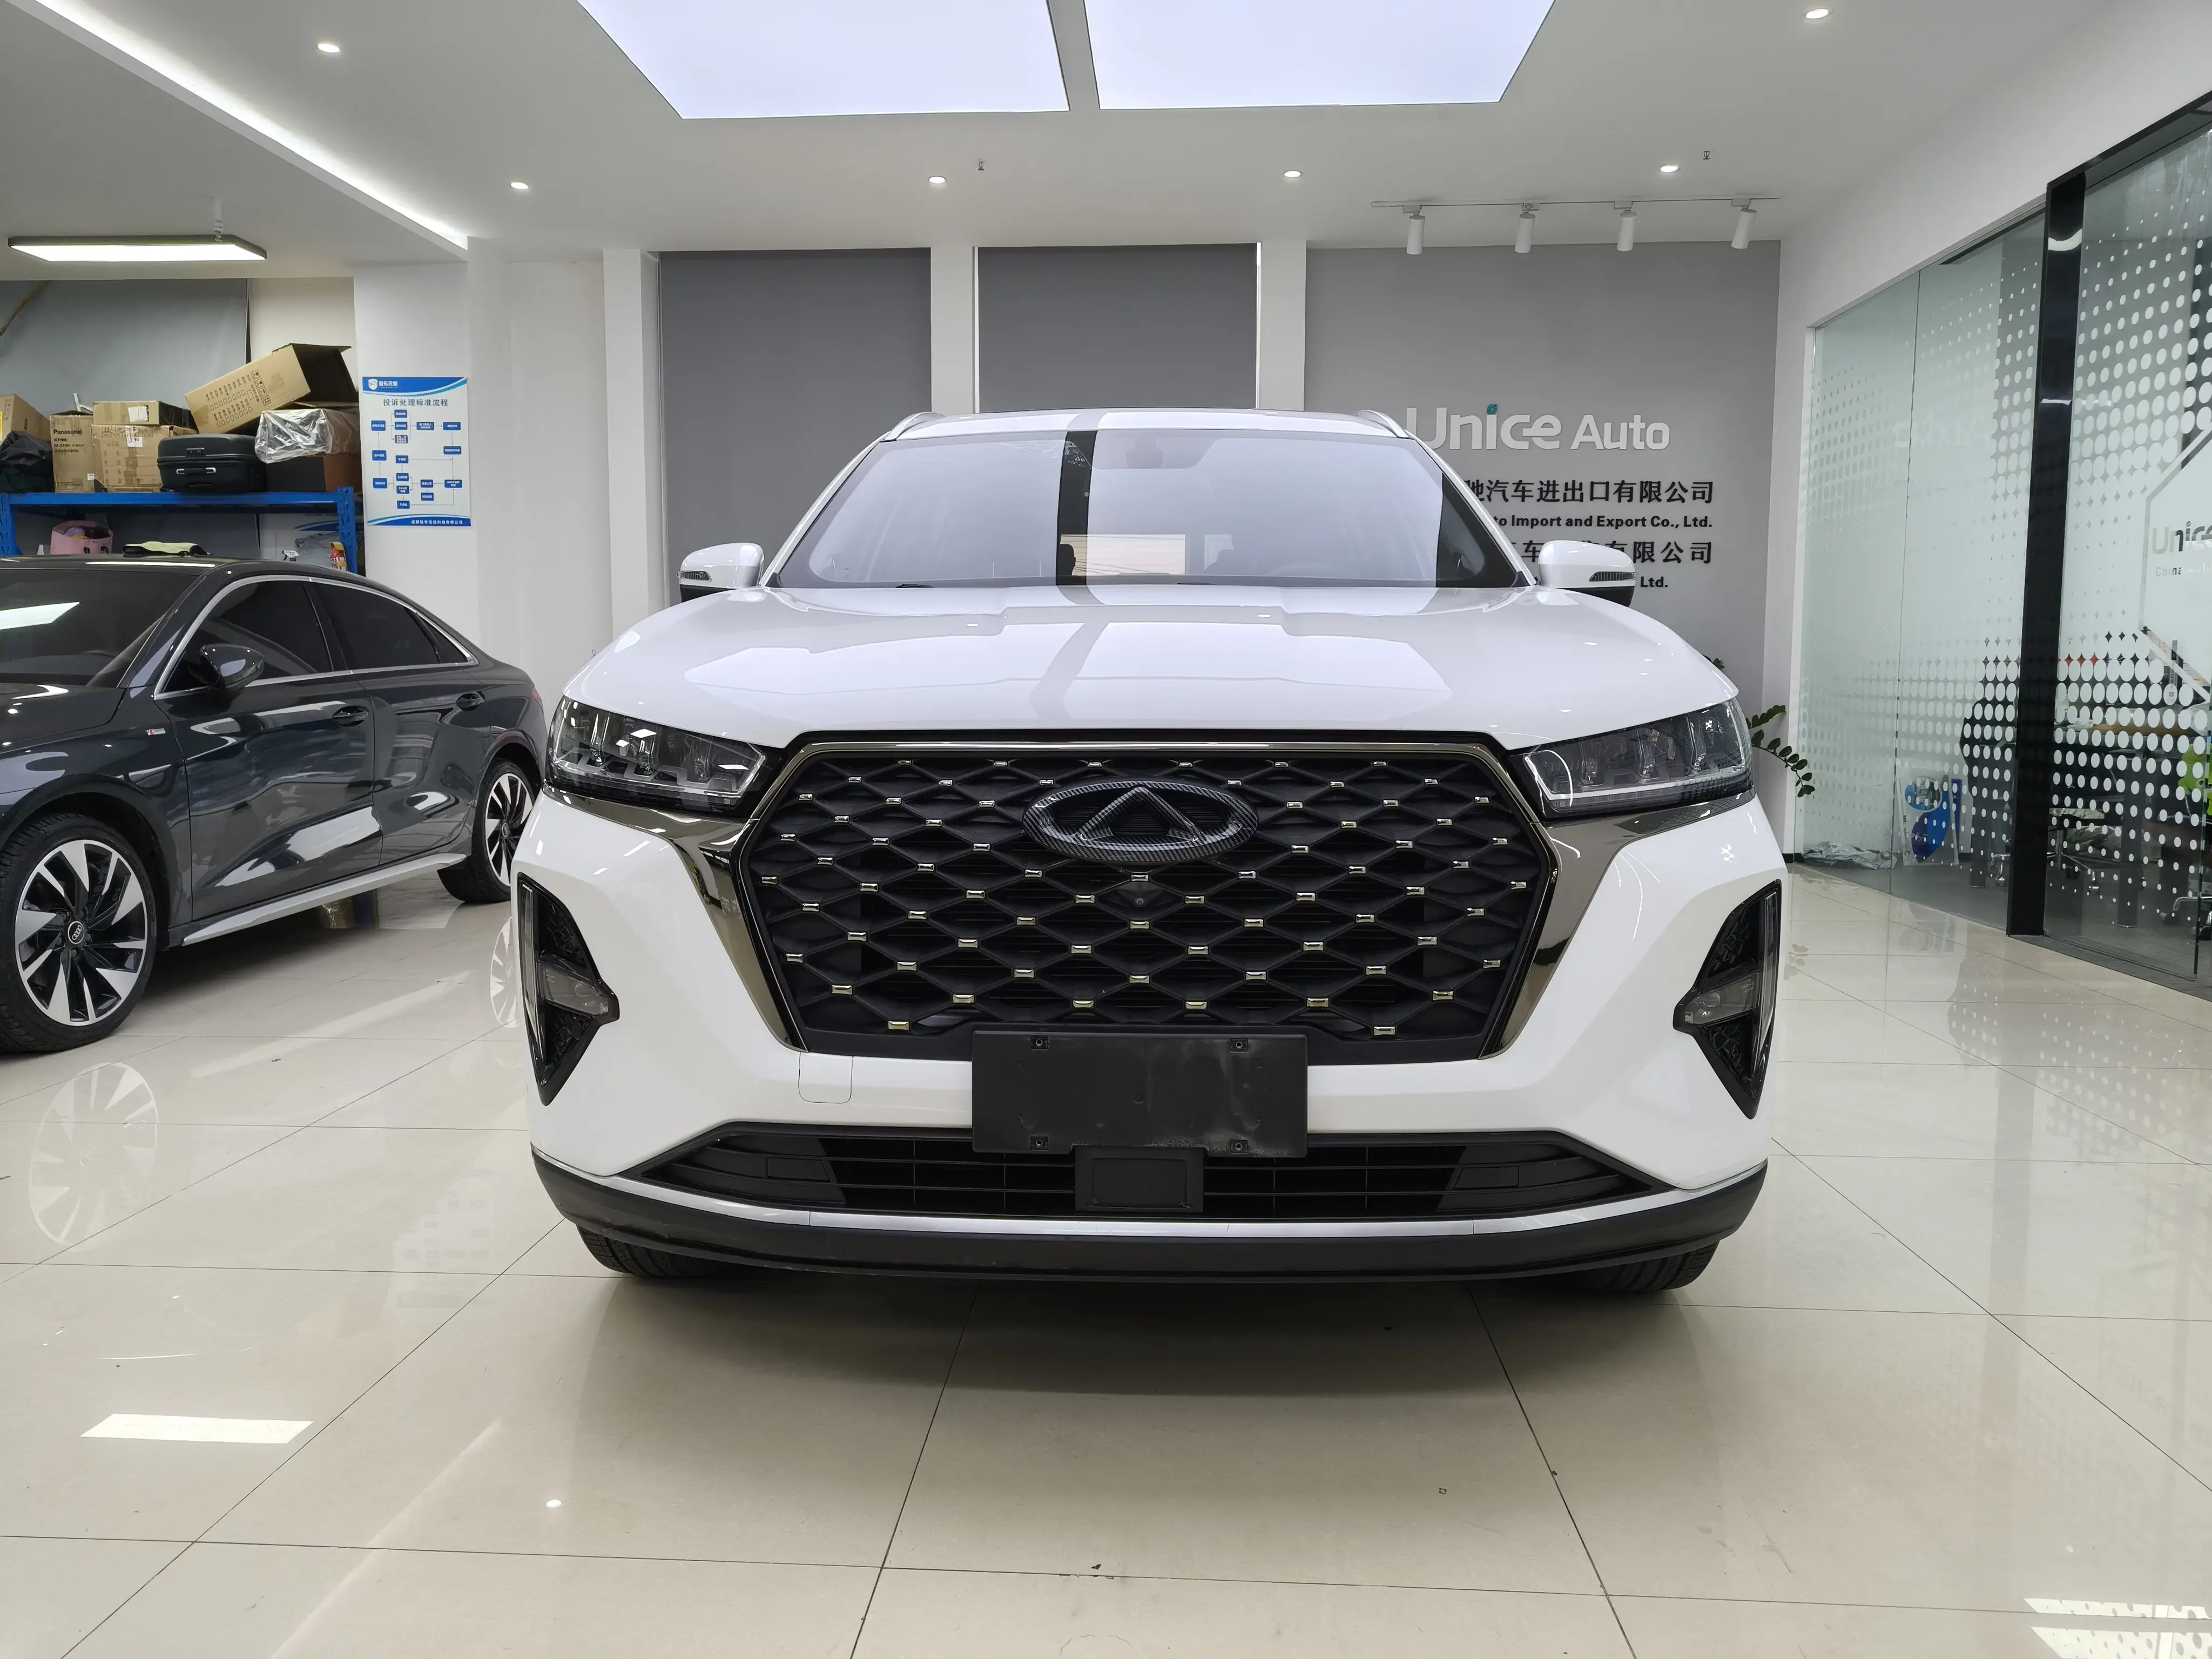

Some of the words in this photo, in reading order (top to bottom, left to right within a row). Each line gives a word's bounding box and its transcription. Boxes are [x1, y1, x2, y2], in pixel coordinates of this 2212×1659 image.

[382, 399, 449, 407] 投诉处理标准流程
[1406, 403, 1562, 449] Unice
[1570, 415, 1670, 450] Auto
[1512, 515, 1562, 529] Import
[1565, 515, 1593, 527] and
[1596, 515, 1647, 530] Export
[1650, 515, 1680, 529] Co.,
[1683, 515, 1712, 528] Ltd.
[1640, 576, 1668, 588] Ltd.
